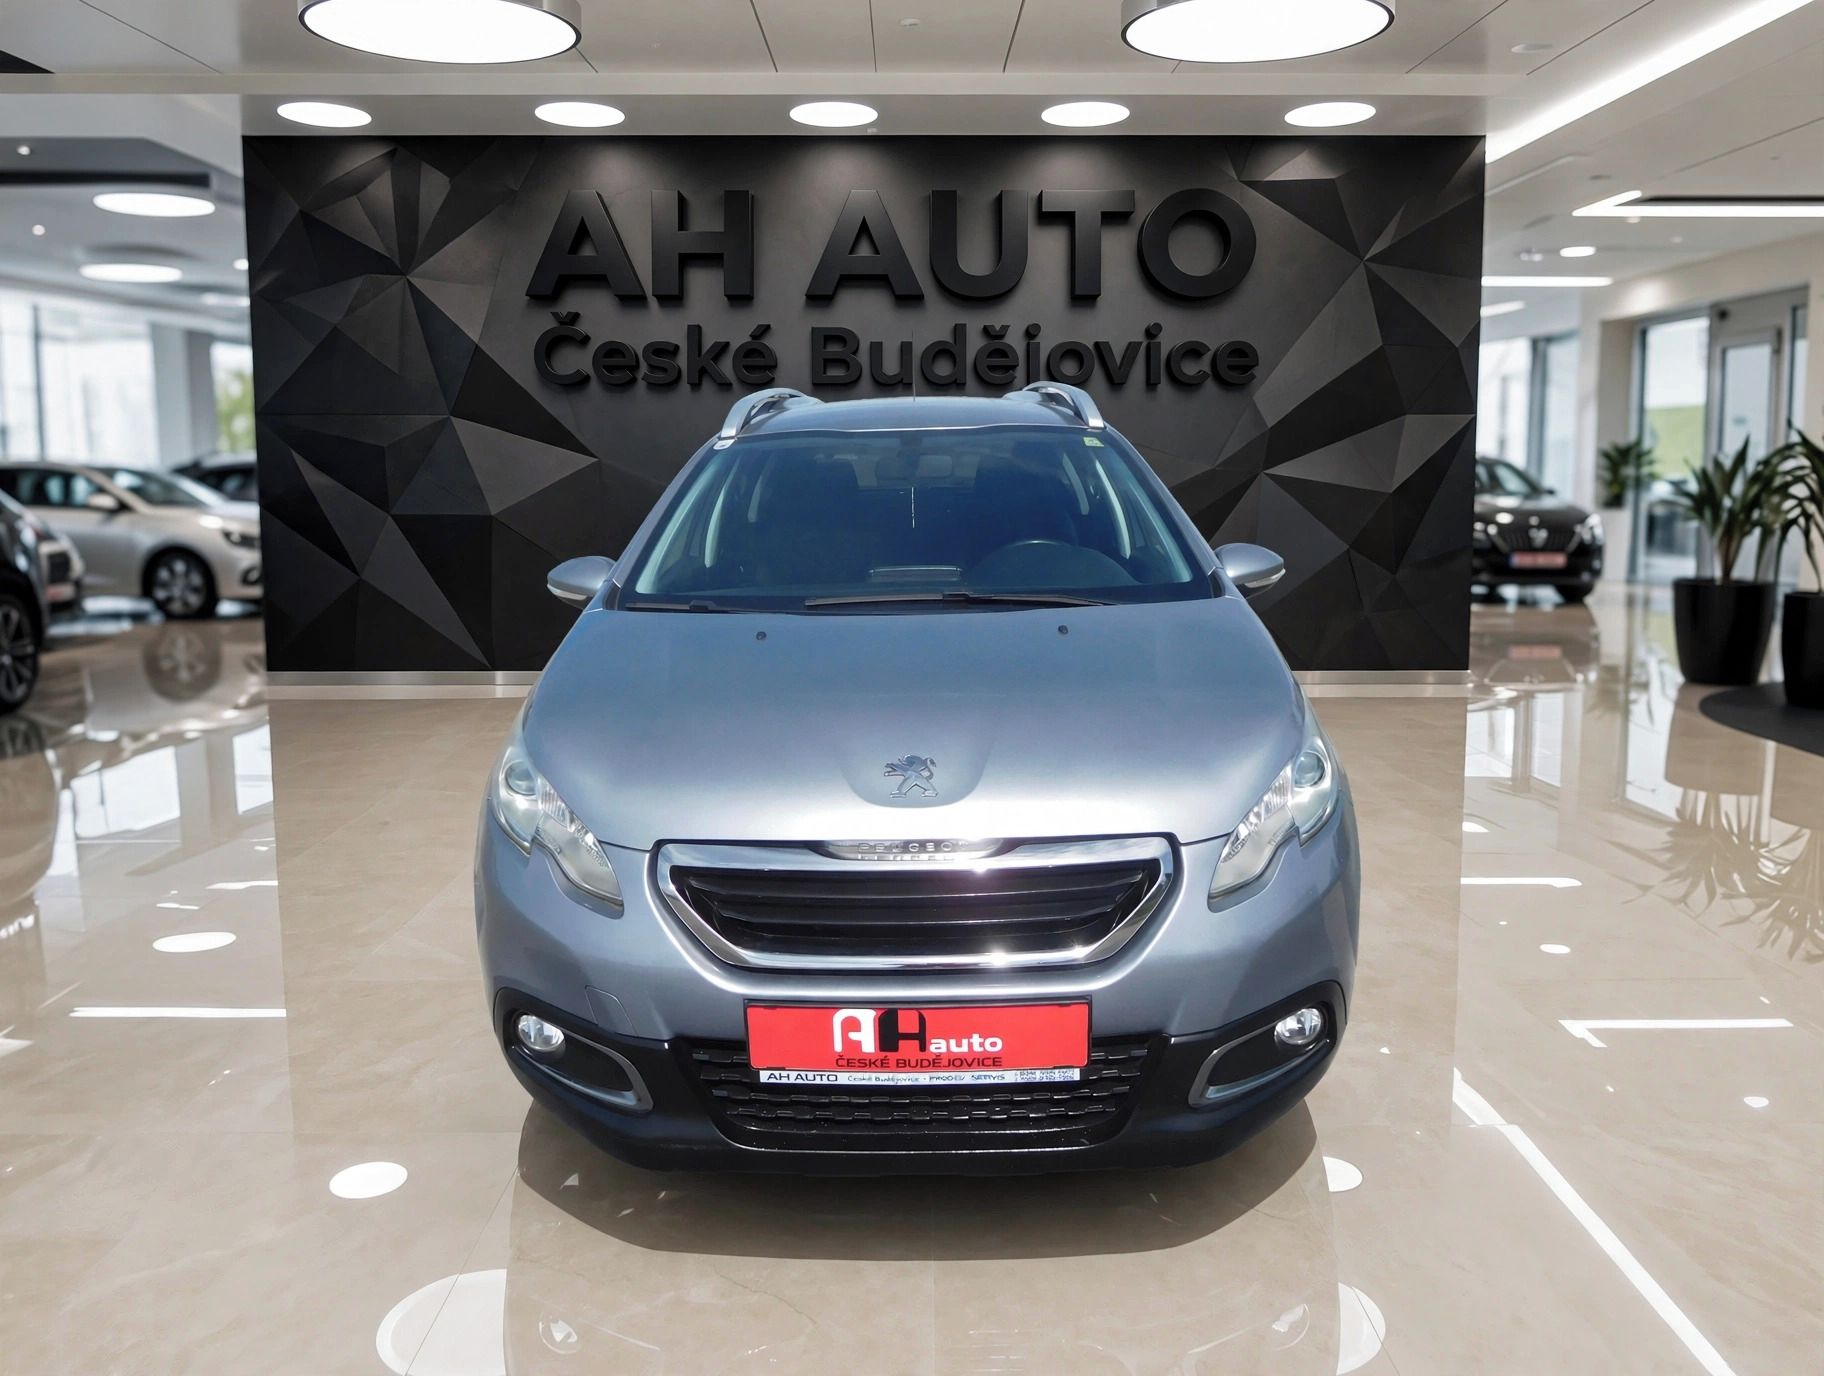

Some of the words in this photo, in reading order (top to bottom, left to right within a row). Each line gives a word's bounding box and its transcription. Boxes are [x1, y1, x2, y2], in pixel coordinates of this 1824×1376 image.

[525, 189, 755, 302] AH
[804, 187, 1258, 301] AUTO
[533, 311, 778, 390] České
[810, 322, 1260, 388] Budějovice
[766, 1072, 790, 1081] AH
[794, 1073, 838, 1082] AUTO
[835, 1055, 890, 1069] ČESKÉ
[896, 1055, 1003, 1069] BUDĚJOVICE
